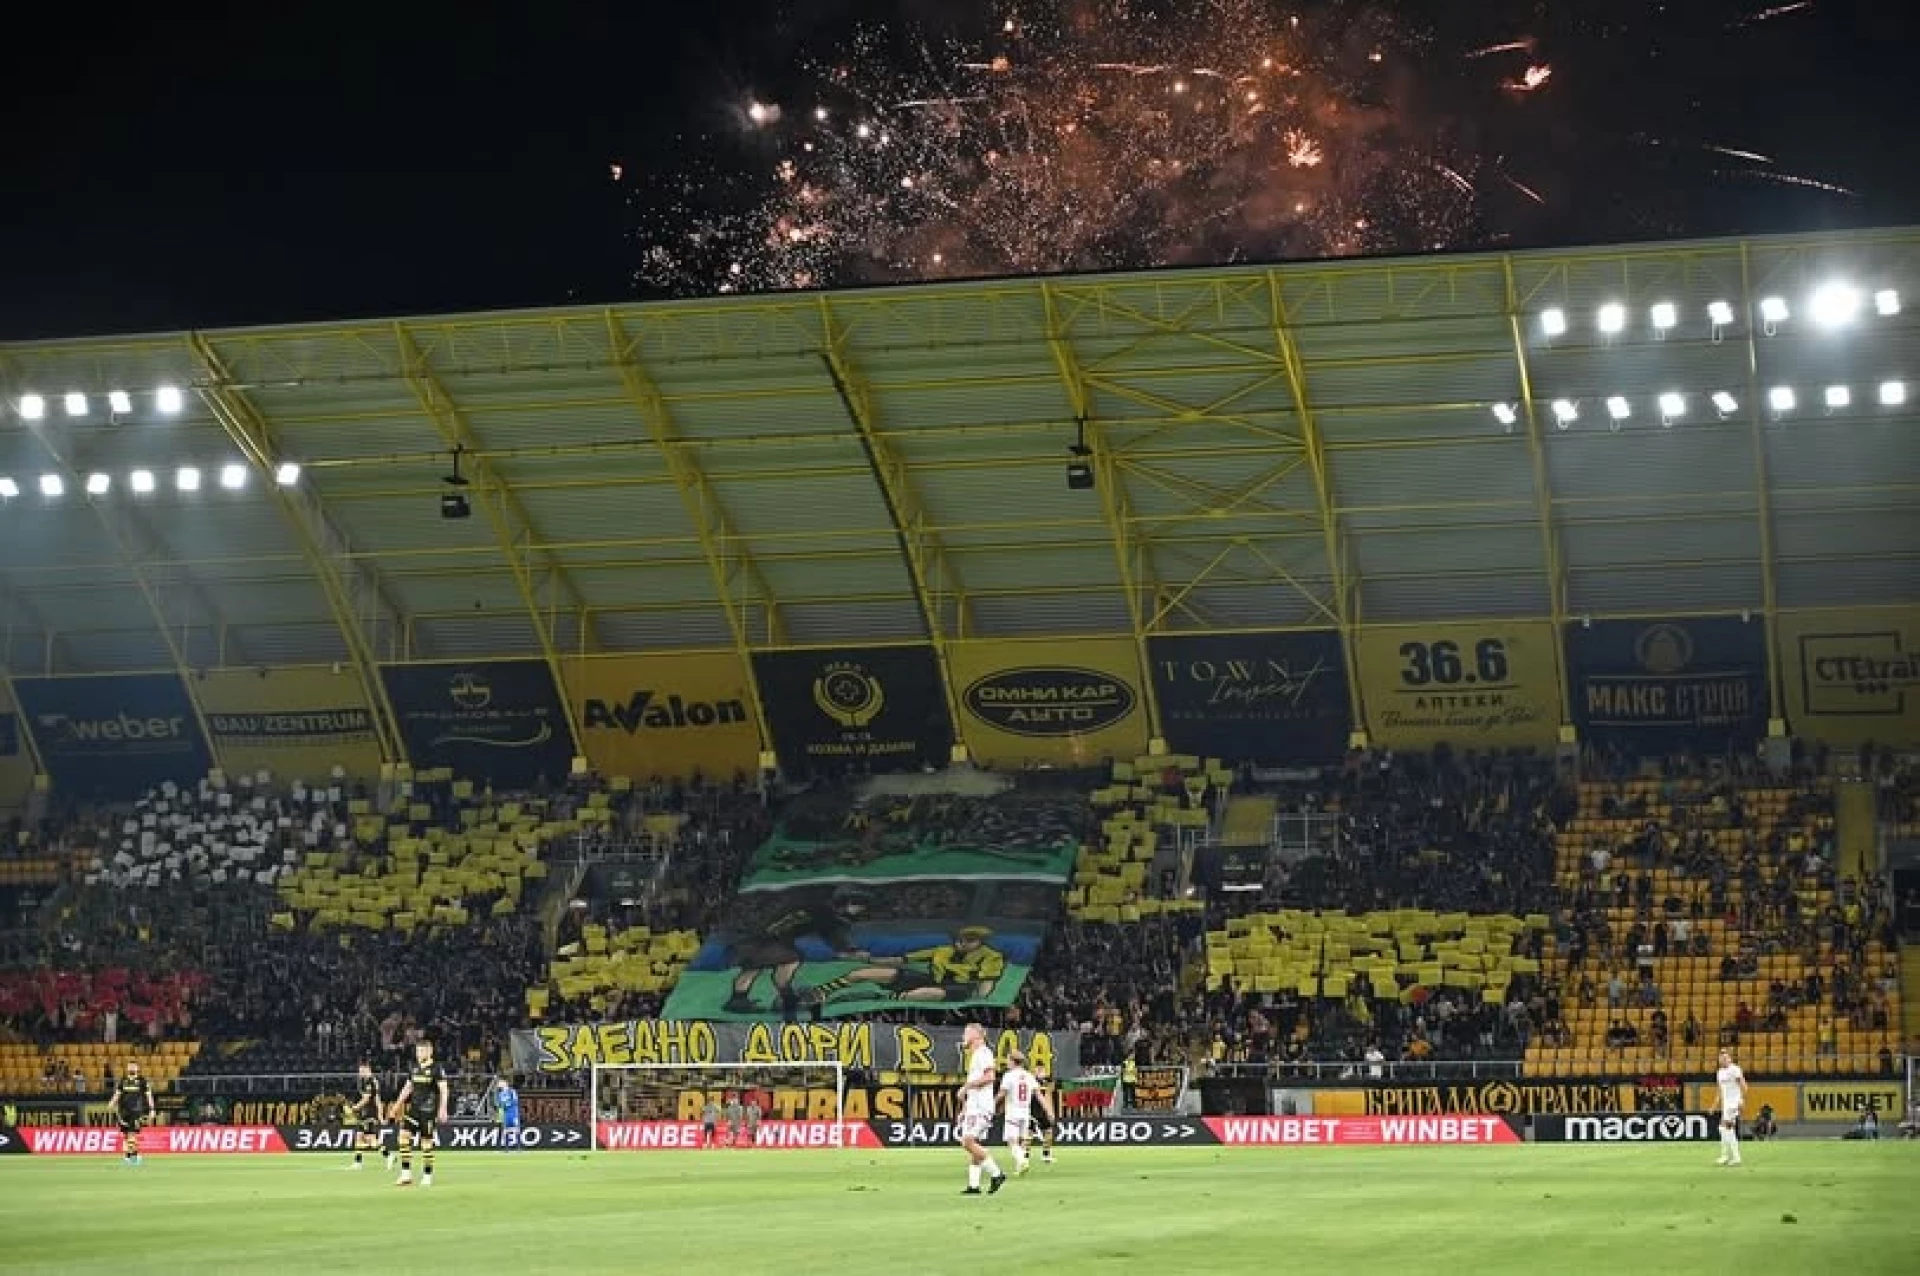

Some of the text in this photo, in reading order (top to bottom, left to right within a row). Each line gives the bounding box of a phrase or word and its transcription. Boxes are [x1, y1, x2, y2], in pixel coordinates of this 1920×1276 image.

[1158, 659, 1290, 682] TOWN
[1400, 637, 1507, 686] 36.6
[978, 685, 1117, 700] ОМНИ КАР
[1416, 695, 1505, 711] АПТЕКИ
[1588, 684, 1667, 717] МАКС
[71, 710, 183, 740] weber
[263, 710, 366, 731] ZENTRUM
[537, 1020, 717, 1071] ЗАЕДНО
[741, 1022, 872, 1068] ДОРИ
[898, 1023, 936, 1075] В
[1807, 1092, 1897, 1112] WINBET
[295, 1127, 393, 1148] ЗАЛГ
[756, 1122, 865, 1145] WINBET
[1055, 1121, 1152, 1142] ЖИВО
[1223, 1118, 1504, 1143] WINBET WINBET
[1564, 1114, 1708, 1140] macron
[33, 1127, 274, 1152] WINBE WINBET
